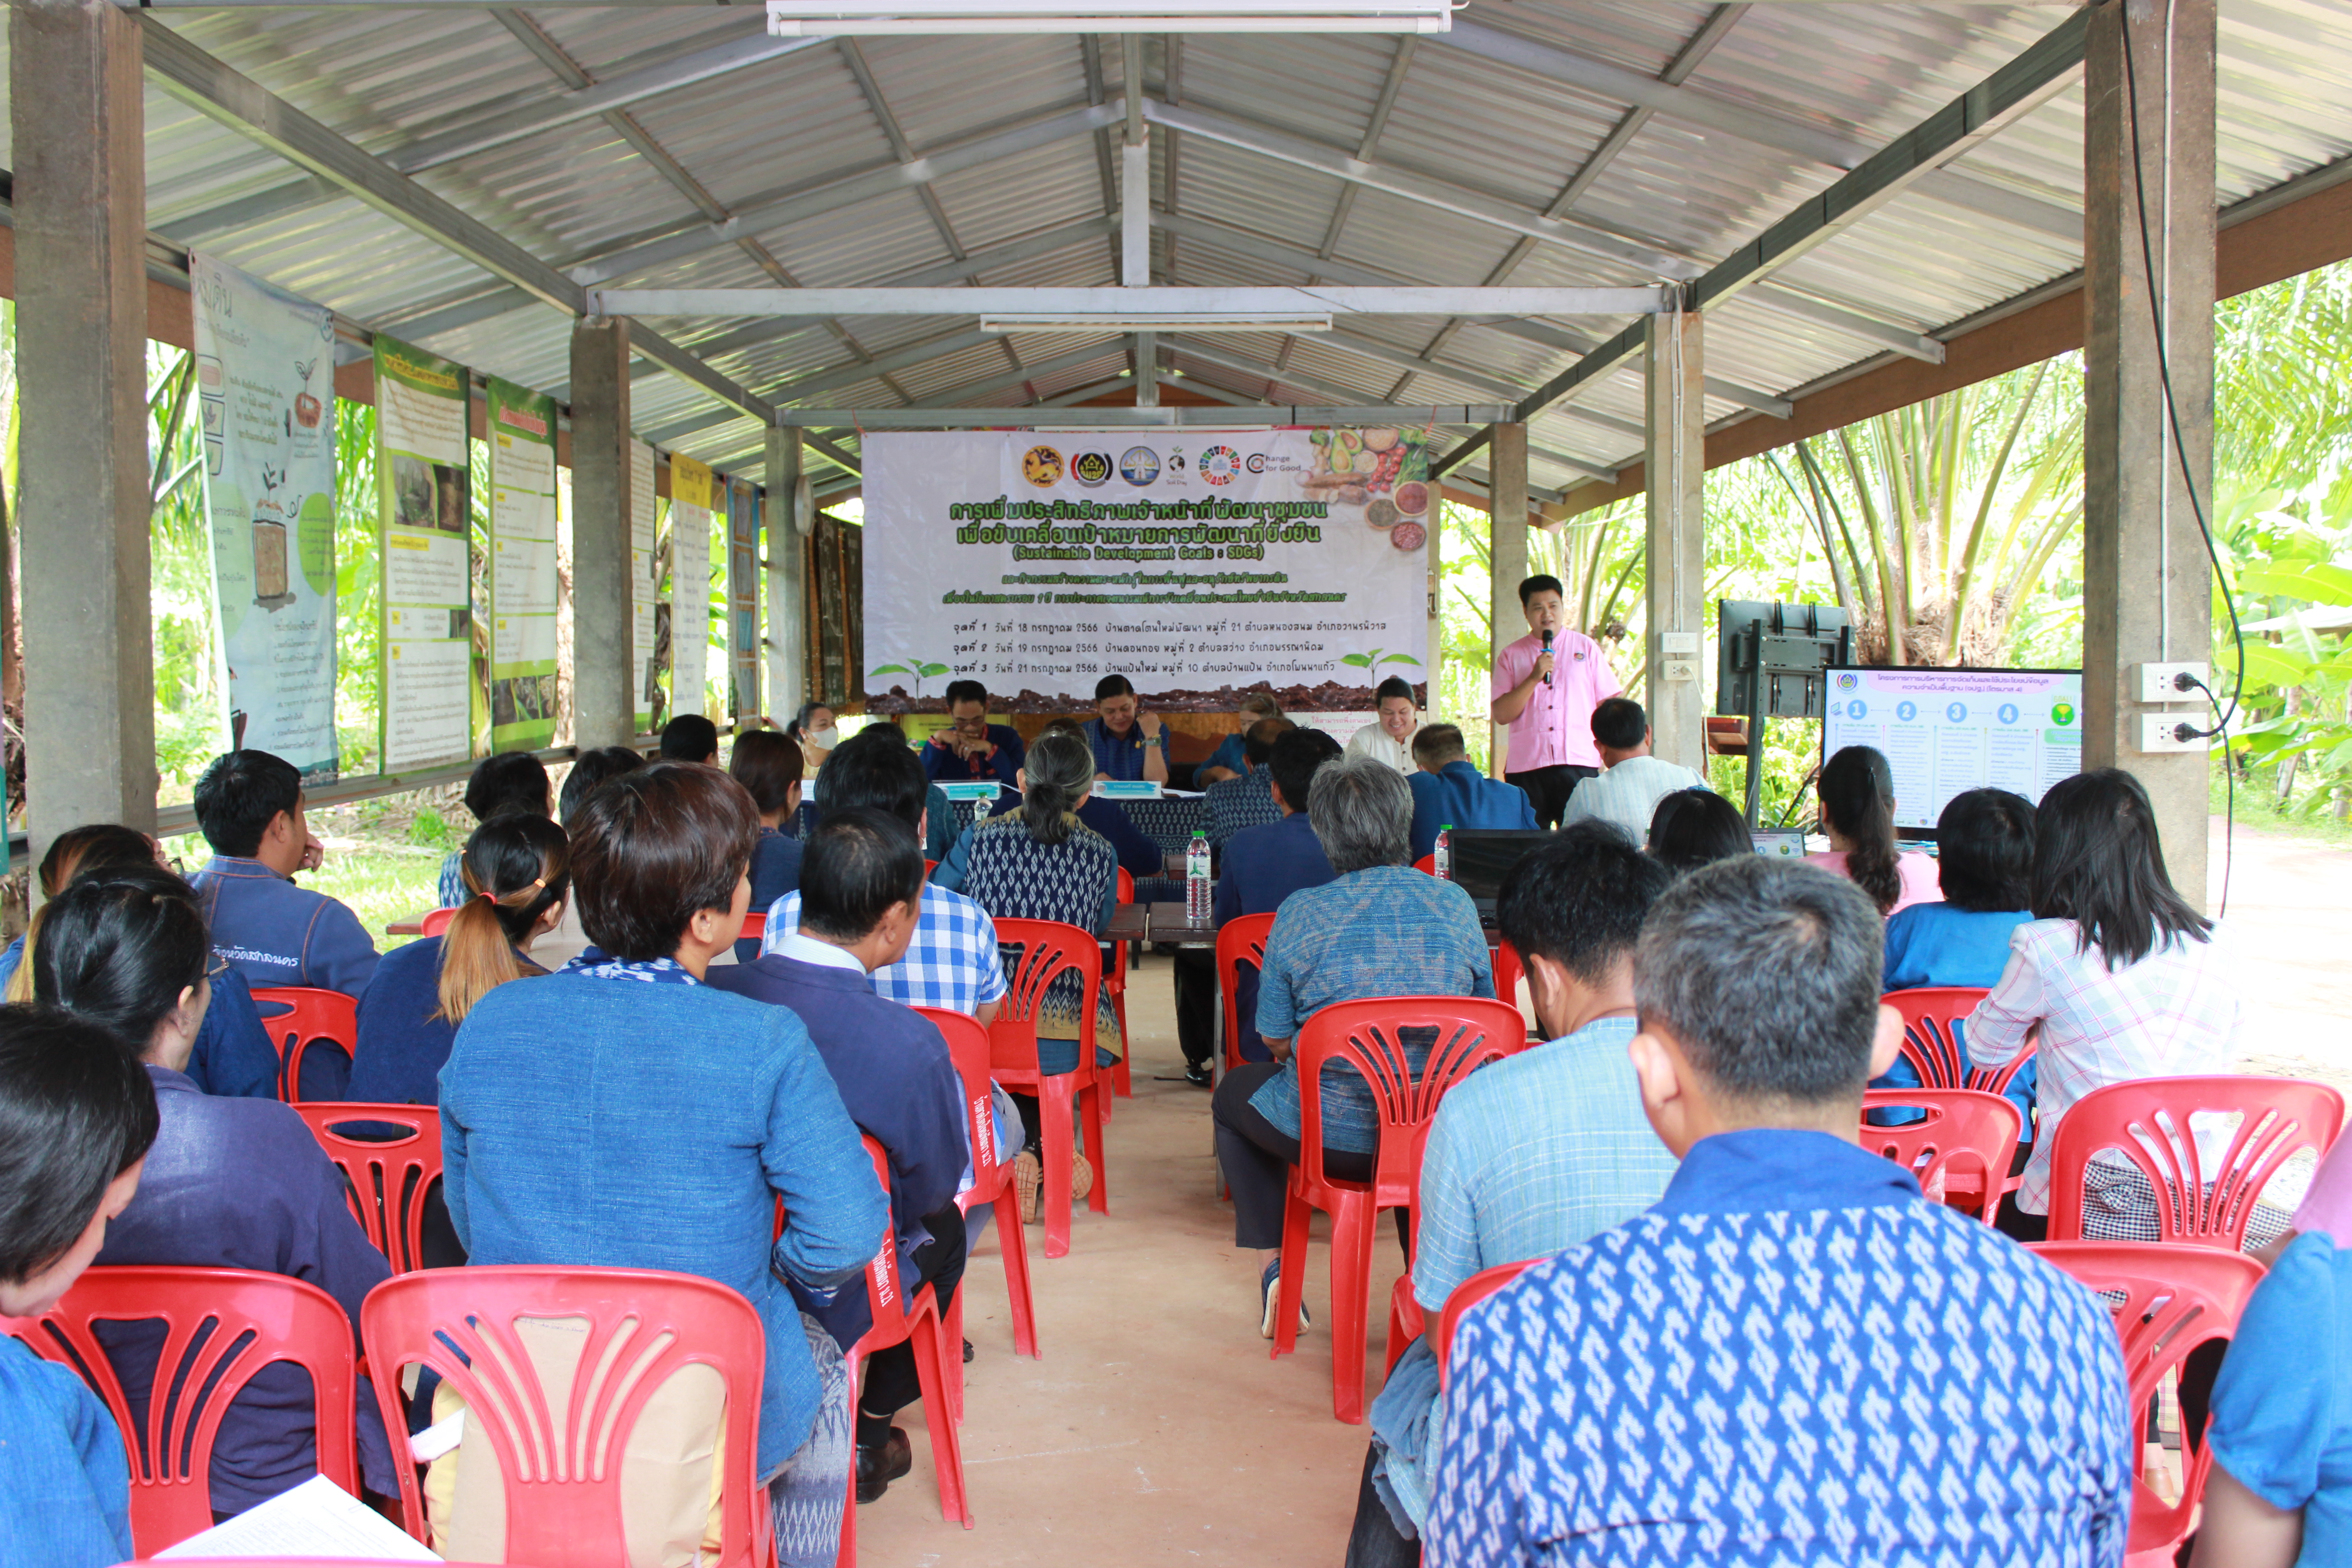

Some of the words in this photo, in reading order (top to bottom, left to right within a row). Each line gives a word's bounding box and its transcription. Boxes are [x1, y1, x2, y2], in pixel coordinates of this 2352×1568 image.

[950, 495, 1328, 524] การเพิ่มประสิทธิภาพเจ้าหน้าที่พัฒนาชุมชน
[956, 519, 1322, 544] เพื่อขับเคลื่อนเป้าหมายการพัฒนาที่ยั่งยืน
[1012, 545, 1091, 563] (Sustainable
[1094, 545, 1175, 563] Development
[1178, 544, 1215, 561] Goals
[1226, 544, 1264, 561] SDGs)
[954, 619, 978, 634] จุดที่
[982, 623, 987, 631] 1
[995, 619, 1013, 632] วันที่
[1018, 623, 1028, 632] 18
[1031, 625, 1072, 635] กรกฎาคม
[1076, 623, 1098, 632] 2566
[1105, 620, 1202, 632] บ้านตาดโตนใหม่พัฒนา
[1206, 618, 1226, 636] หมู่ที่
[1231, 622, 1240, 631] 21
[1245, 621, 1313, 632] ตำบลหนองสนม
[1317, 620, 1386, 631] อำเภอวานรนิวาส
[954, 640, 978, 655] จุดที่
[981, 643, 987, 652] 2
[995, 639, 1013, 652] วันที่
[1018, 643, 1027, 652] 19
[1031, 645, 1072, 655] กรกฎาคม
[1076, 643, 1098, 652] 2566
[1105, 642, 1160, 652] บ้านดอนกอย
[1164, 639, 1185, 657] หมู่ที่
[1189, 643, 1194, 652] 2
[1198, 642, 1245, 652] ตำบลสว่าง
[1249, 641, 1323, 652] อำเภอพรรณานิคม
[954, 660, 978, 675] จุดที่
[981, 663, 987, 672] 3
[995, 659, 1013, 673] วันที่
[1018, 663, 1027, 673] 21
[1031, 665, 1072, 675] กรกฎาคม
[1076, 663, 1097, 672] 2566
[1105, 661, 1157, 672] บ้านแป้นใหม่
[1162, 659, 1183, 676] หมู่ที่
[1188, 664, 1198, 672] 10
[1203, 662, 1262, 672] ตำบลบ้านแป้น
[1266, 659, 1335, 671] อำเภอโพนนาแก้ว
[1852, 703, 1861, 716] 1
[1902, 705, 1911, 718] 2
[1951, 706, 1961, 719] 3
[2003, 706, 2012, 720] 4
[212, 944, 299, 967] จังหวัดสกลนคร
